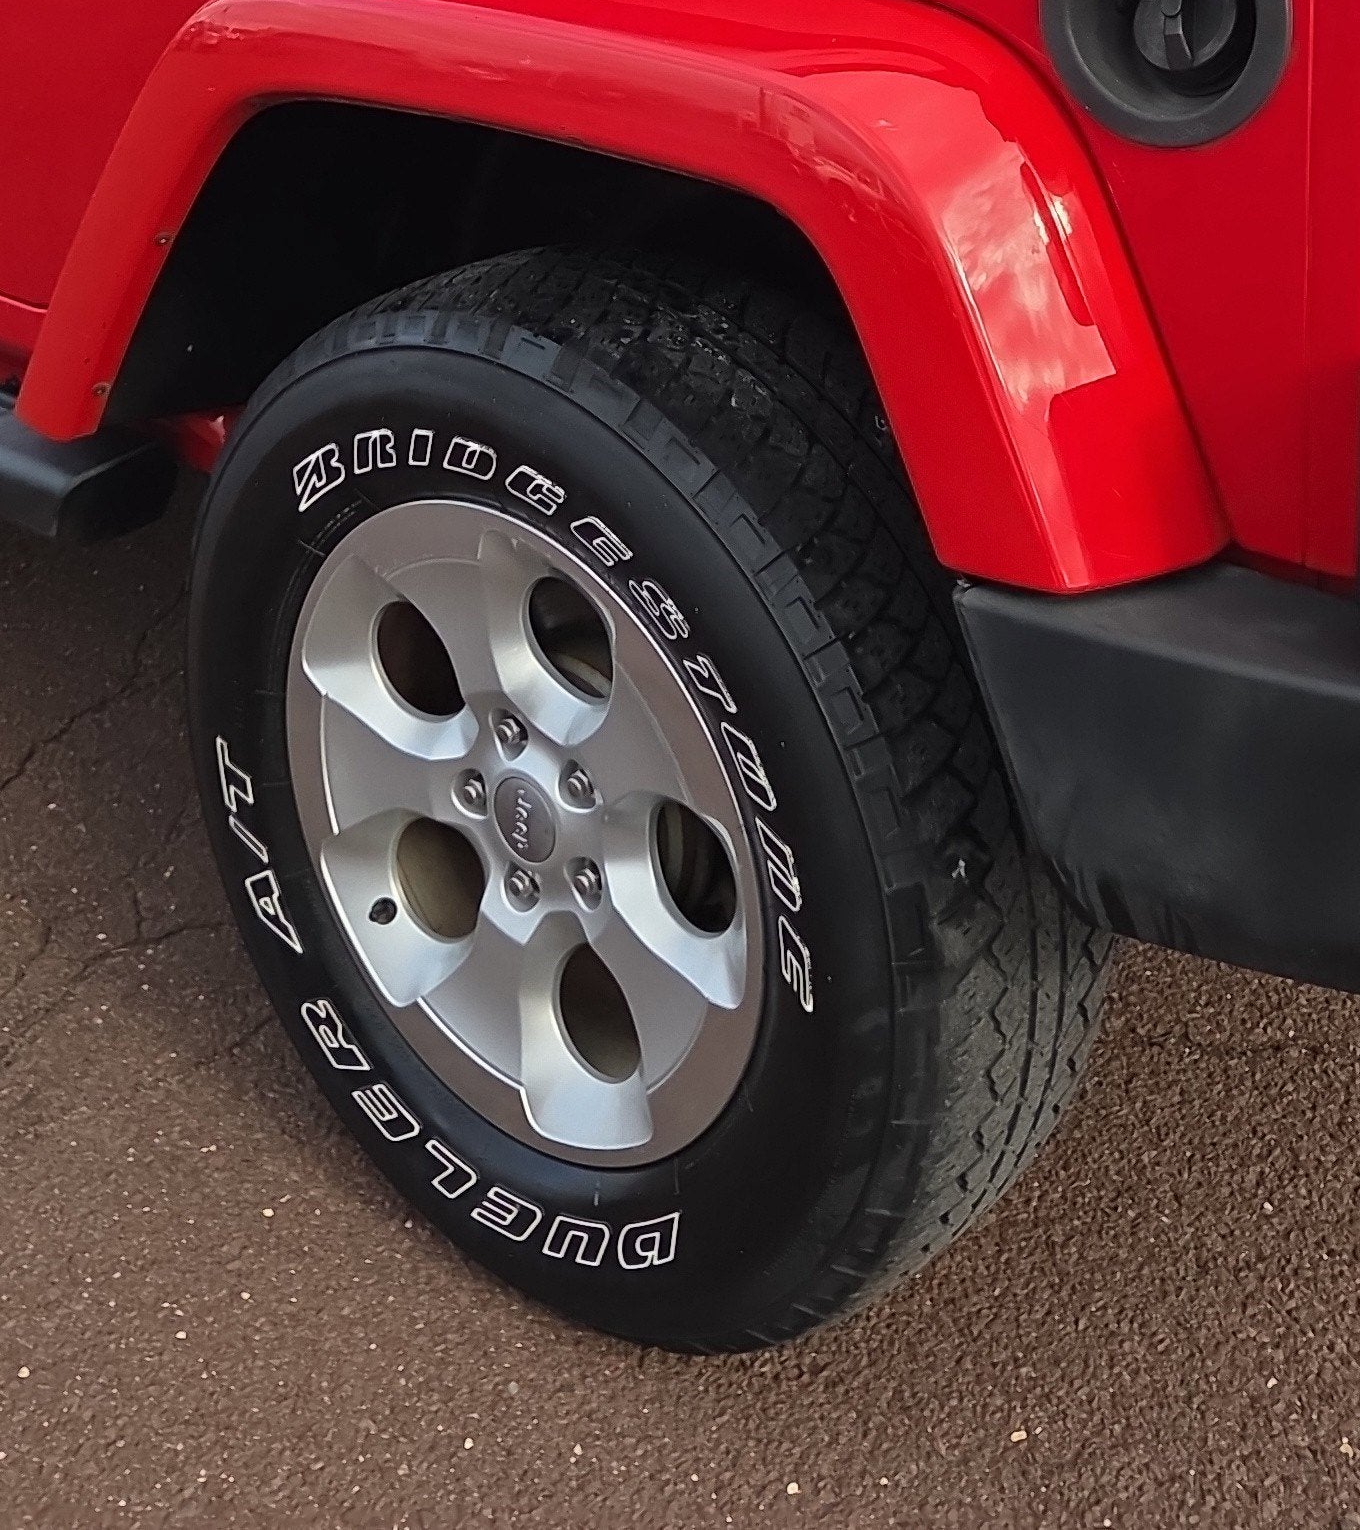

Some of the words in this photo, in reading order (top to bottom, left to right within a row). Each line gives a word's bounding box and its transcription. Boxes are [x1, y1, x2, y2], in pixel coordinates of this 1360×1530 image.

[216, 735, 304, 955] A/T
[292, 427, 817, 1012] BRIDGESTONE
[303, 998, 682, 1270] DUELER
